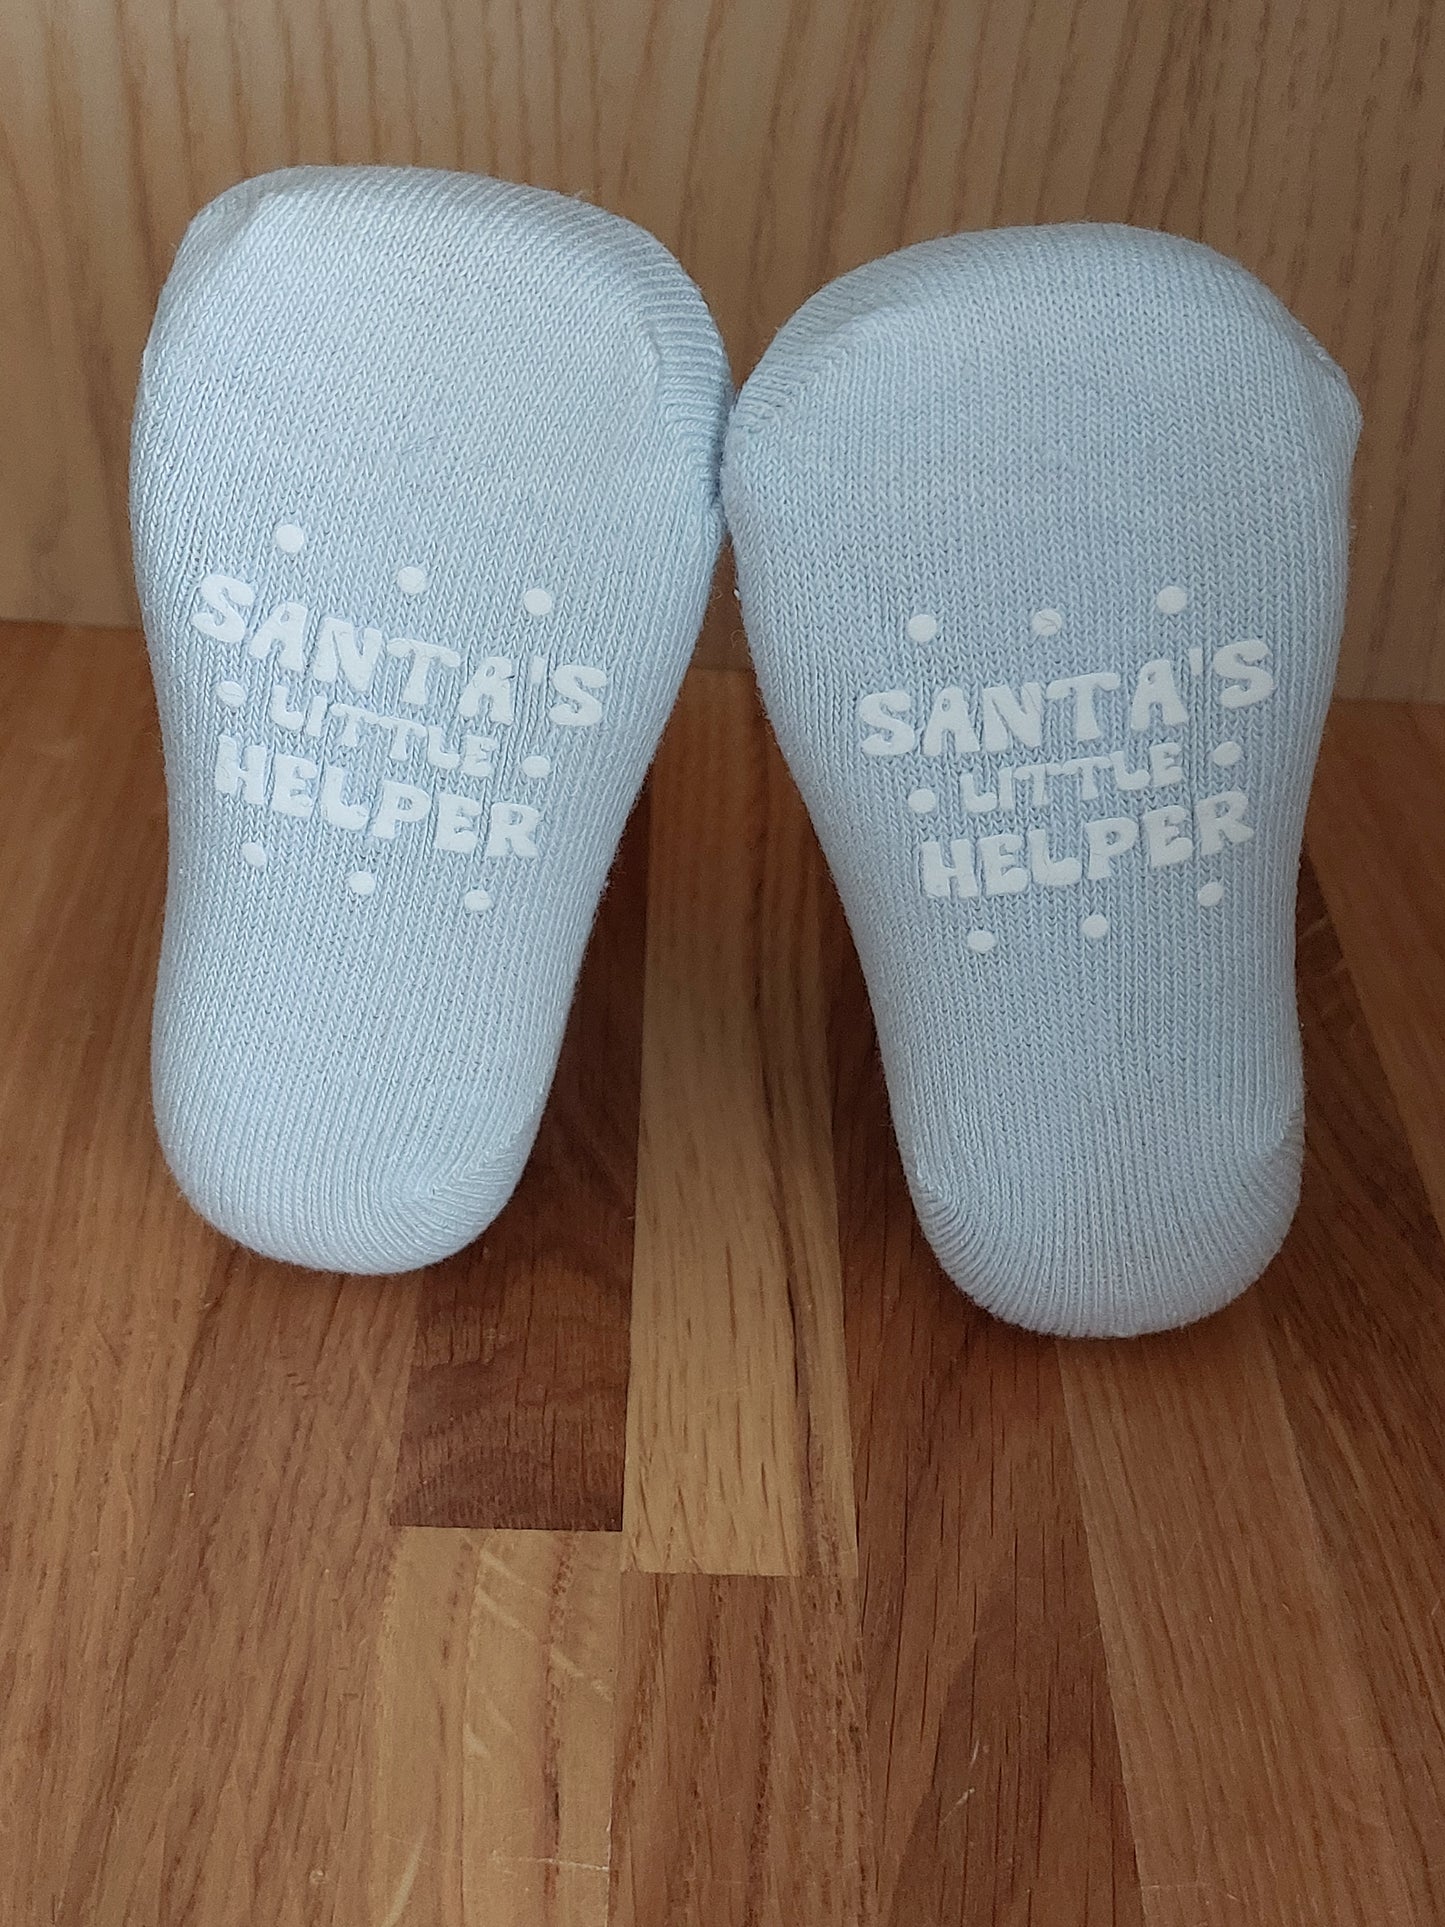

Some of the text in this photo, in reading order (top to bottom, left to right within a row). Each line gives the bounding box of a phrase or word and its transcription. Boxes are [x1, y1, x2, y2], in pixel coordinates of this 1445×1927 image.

[191, 574, 608, 727] SANTA'S
[858, 639, 1276, 756] SANTA'S
[271, 685, 499, 778] LITTLE
[960, 742, 1183, 813] LITTLE
[214, 735, 541, 858] HELPER
[920, 790, 1254, 899] HELPER
